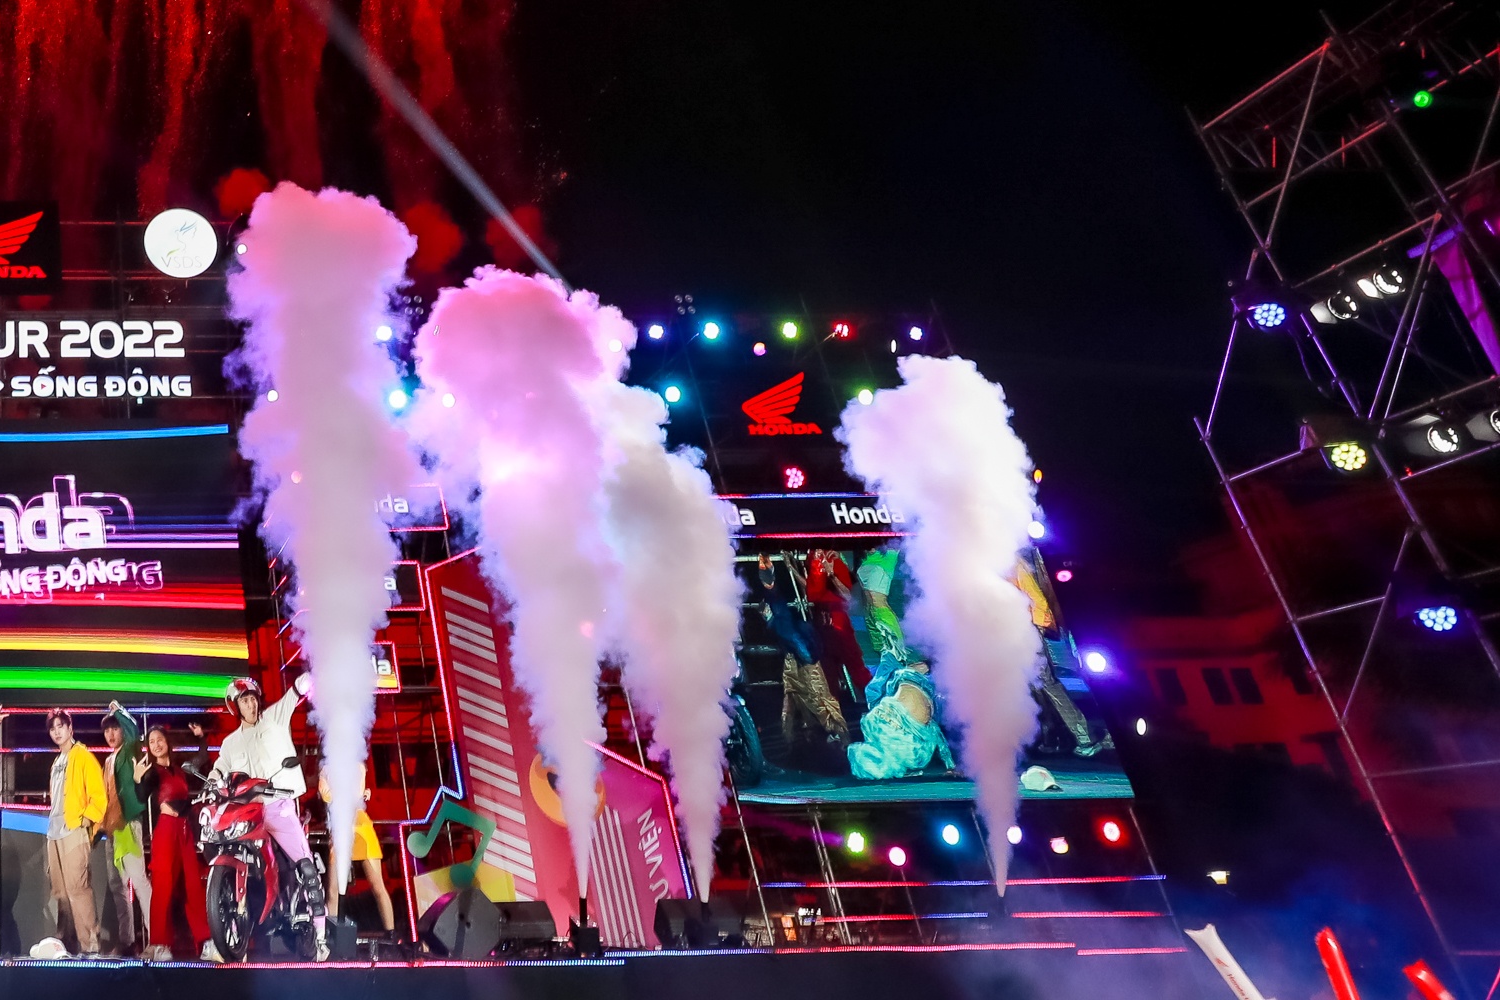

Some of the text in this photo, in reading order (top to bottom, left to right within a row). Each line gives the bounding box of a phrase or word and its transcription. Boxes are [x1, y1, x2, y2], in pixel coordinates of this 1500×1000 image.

[160, 255, 203, 269] VSDS
[60, 320, 185, 358] 2022
[10, 365, 98, 398] SỐNG
[104, 367, 192, 404] ĐỘNG
[749, 422, 822, 436] HONDA
[831, 502, 906, 525] Honda
[47, 557, 127, 592] ĐỘNG
